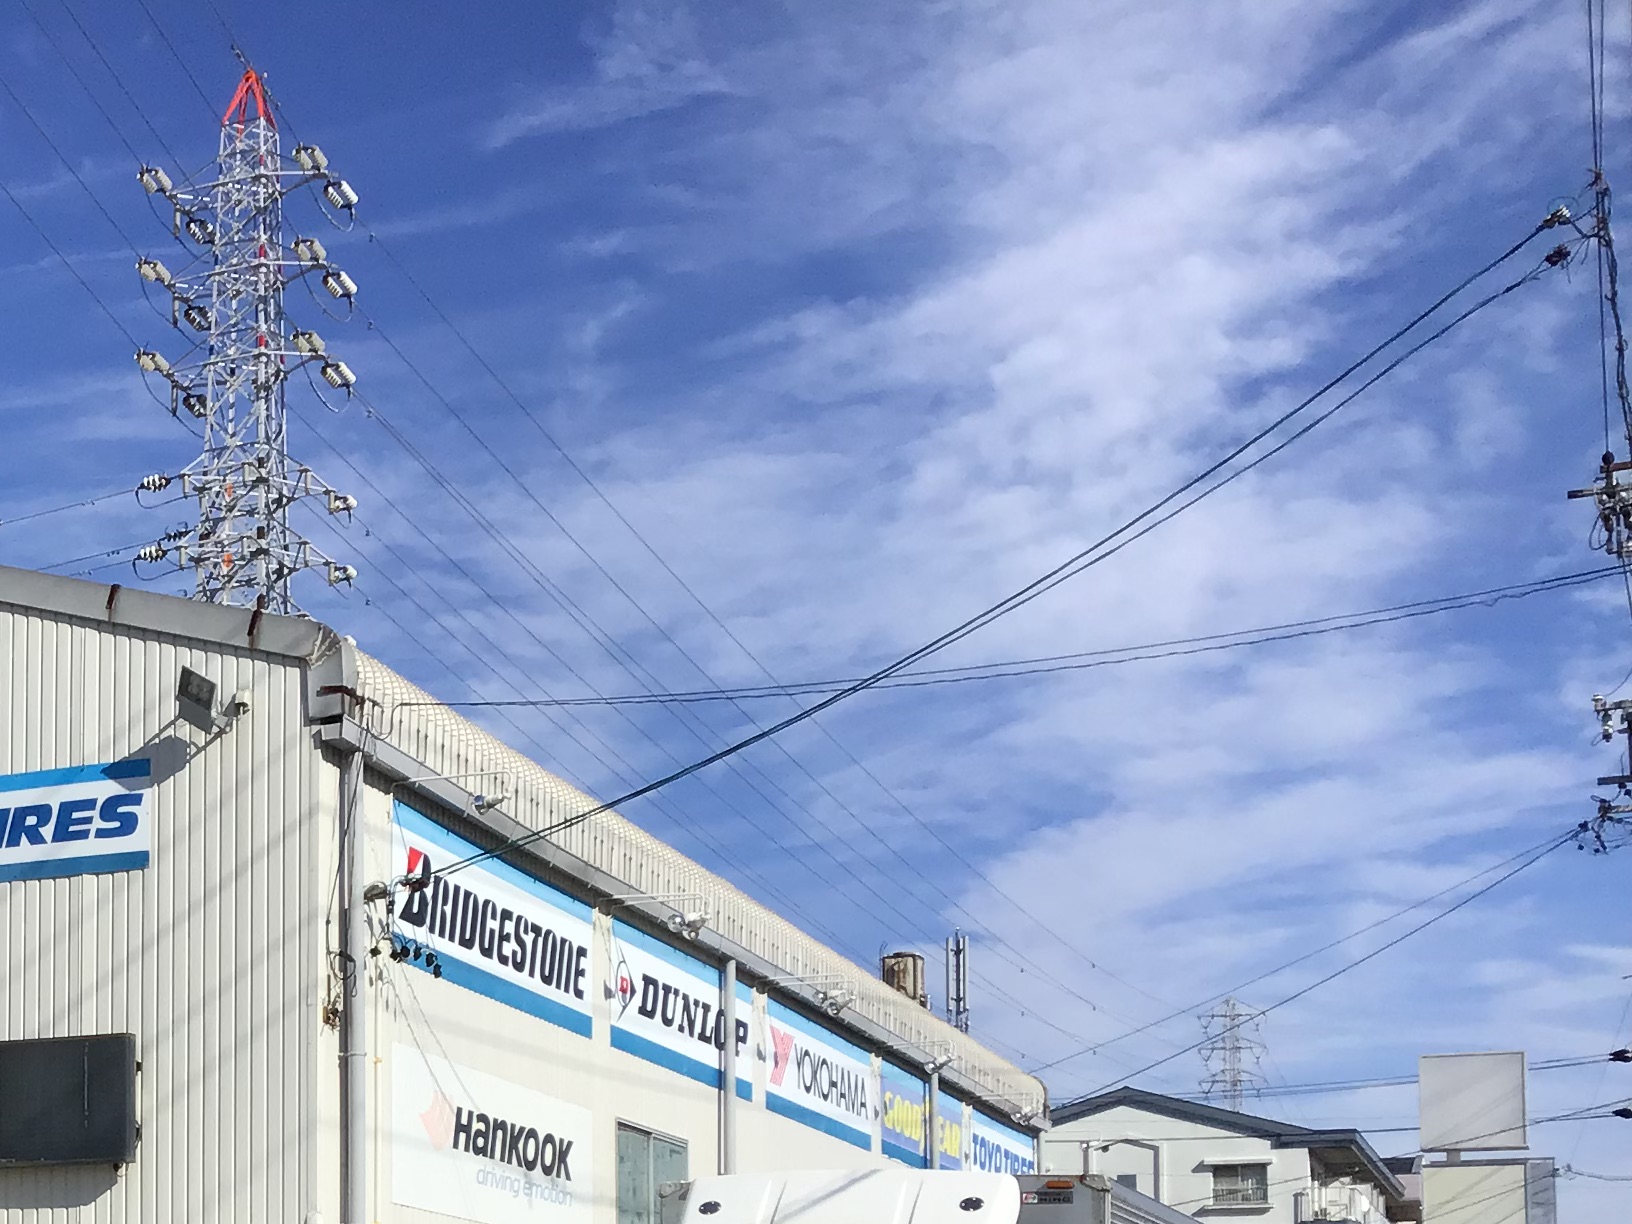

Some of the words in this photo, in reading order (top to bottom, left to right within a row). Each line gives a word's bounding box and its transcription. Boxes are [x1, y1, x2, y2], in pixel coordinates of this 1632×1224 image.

[399, 846, 588, 1000] BRIDGESTONE
[794, 1043, 869, 1119] YOKOHAMA
[883, 1090, 961, 1159] GOODEAR
[972, 1132, 1003, 1174] TOYO
[477, 1166, 520, 1198] driving
[523, 1180, 573, 1207] emotion
